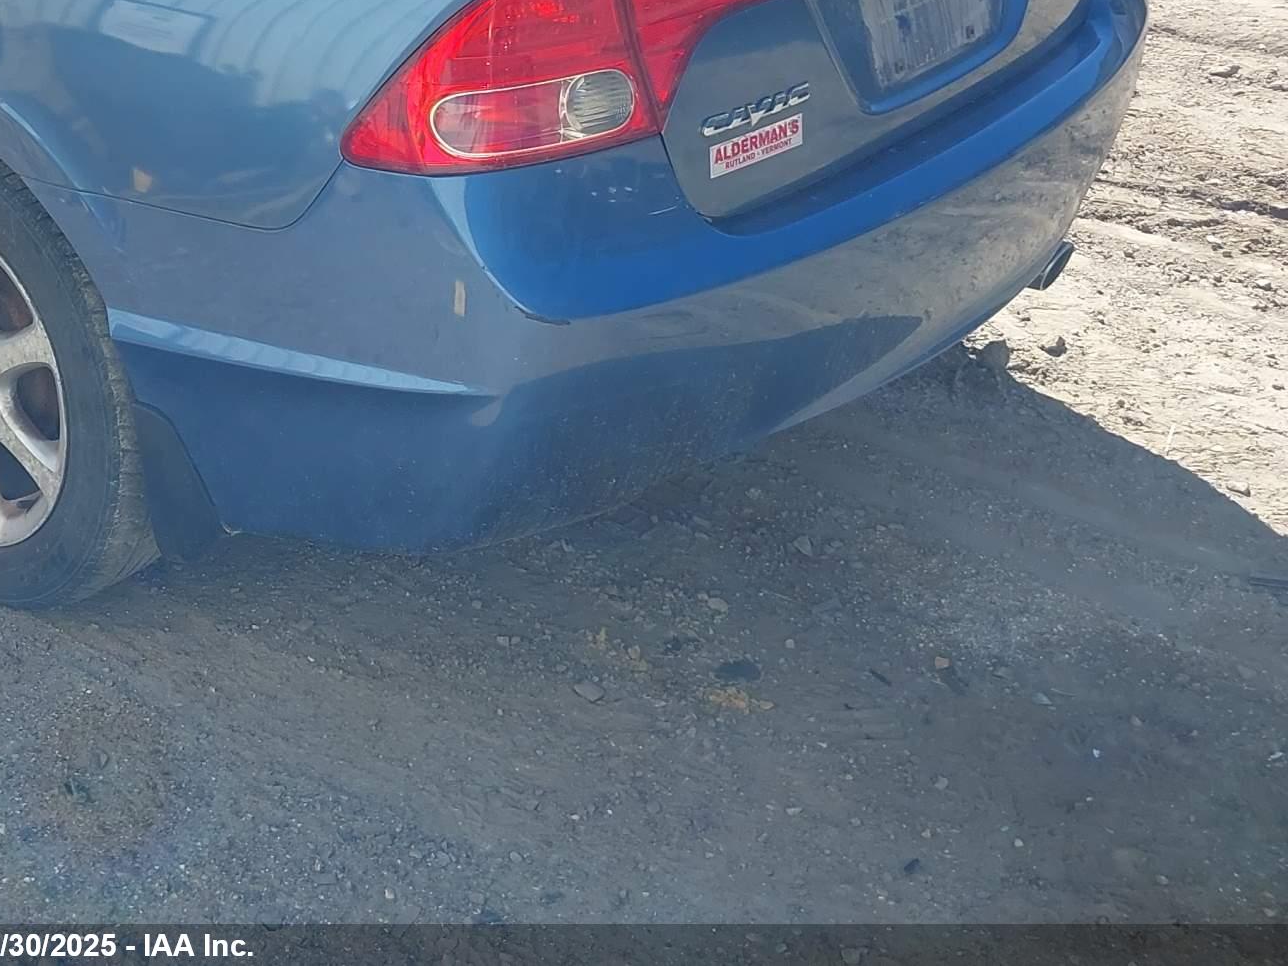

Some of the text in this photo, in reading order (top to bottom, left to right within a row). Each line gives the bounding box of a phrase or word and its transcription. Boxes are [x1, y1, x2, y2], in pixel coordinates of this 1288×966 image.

[701, 81, 810, 136] CIVIC
[714, 119, 800, 165] ALDERMAN'S
[725, 137, 793, 170] RUTLAND VERMONT
